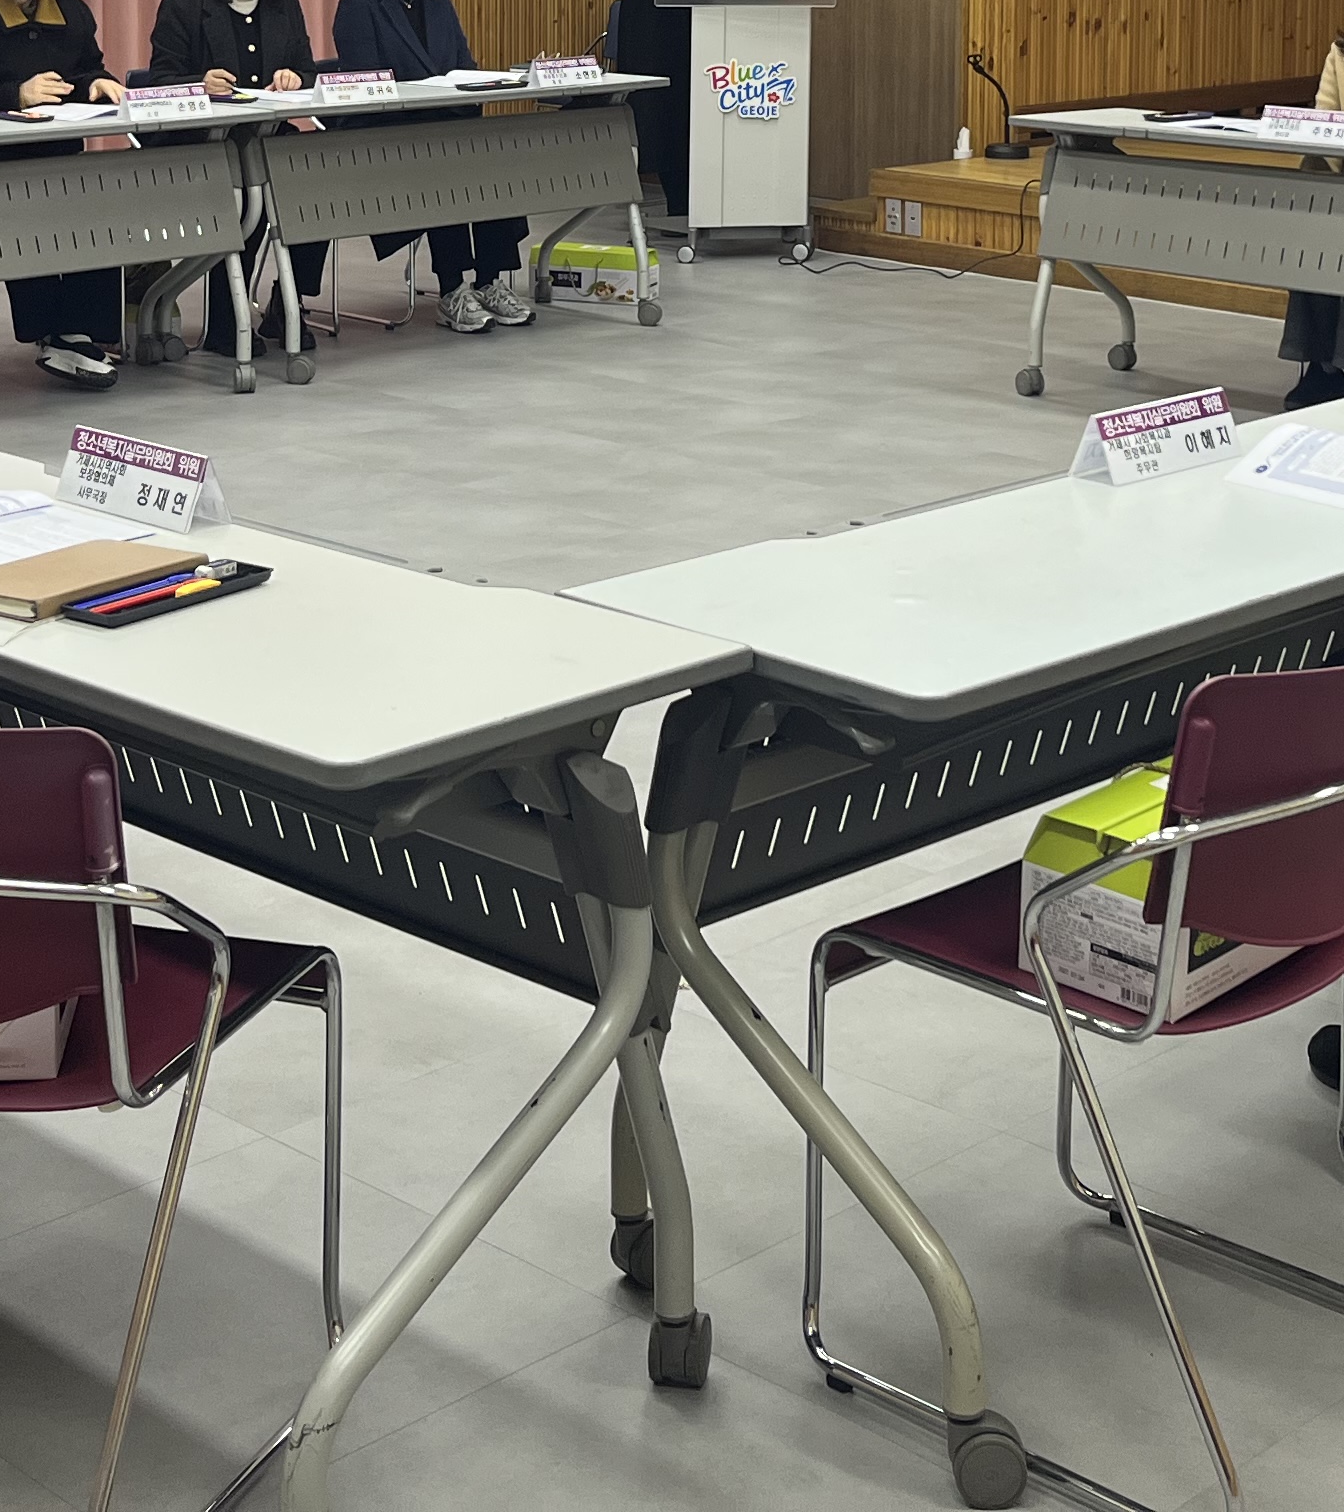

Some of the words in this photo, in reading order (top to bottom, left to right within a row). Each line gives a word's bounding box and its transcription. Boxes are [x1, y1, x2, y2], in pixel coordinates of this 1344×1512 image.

[706, 61, 766, 89] Blue
[720, 82, 765, 110] City
[741, 106, 778, 117] GEOJE
[1102, 399, 1202, 437] 청소년복지실무위원회
[1201, 393, 1225, 414] 위원
[1184, 425, 1232, 453] 이예지
[76, 430, 176, 472] 청소년복지실무위원회
[178, 455, 201, 478] 위원
[76, 453, 128, 477] 거제시지역사회
[78, 467, 117, 487] 보장협의체
[77, 485, 108, 505] 사무국장
[136, 482, 188, 516] 정재연
